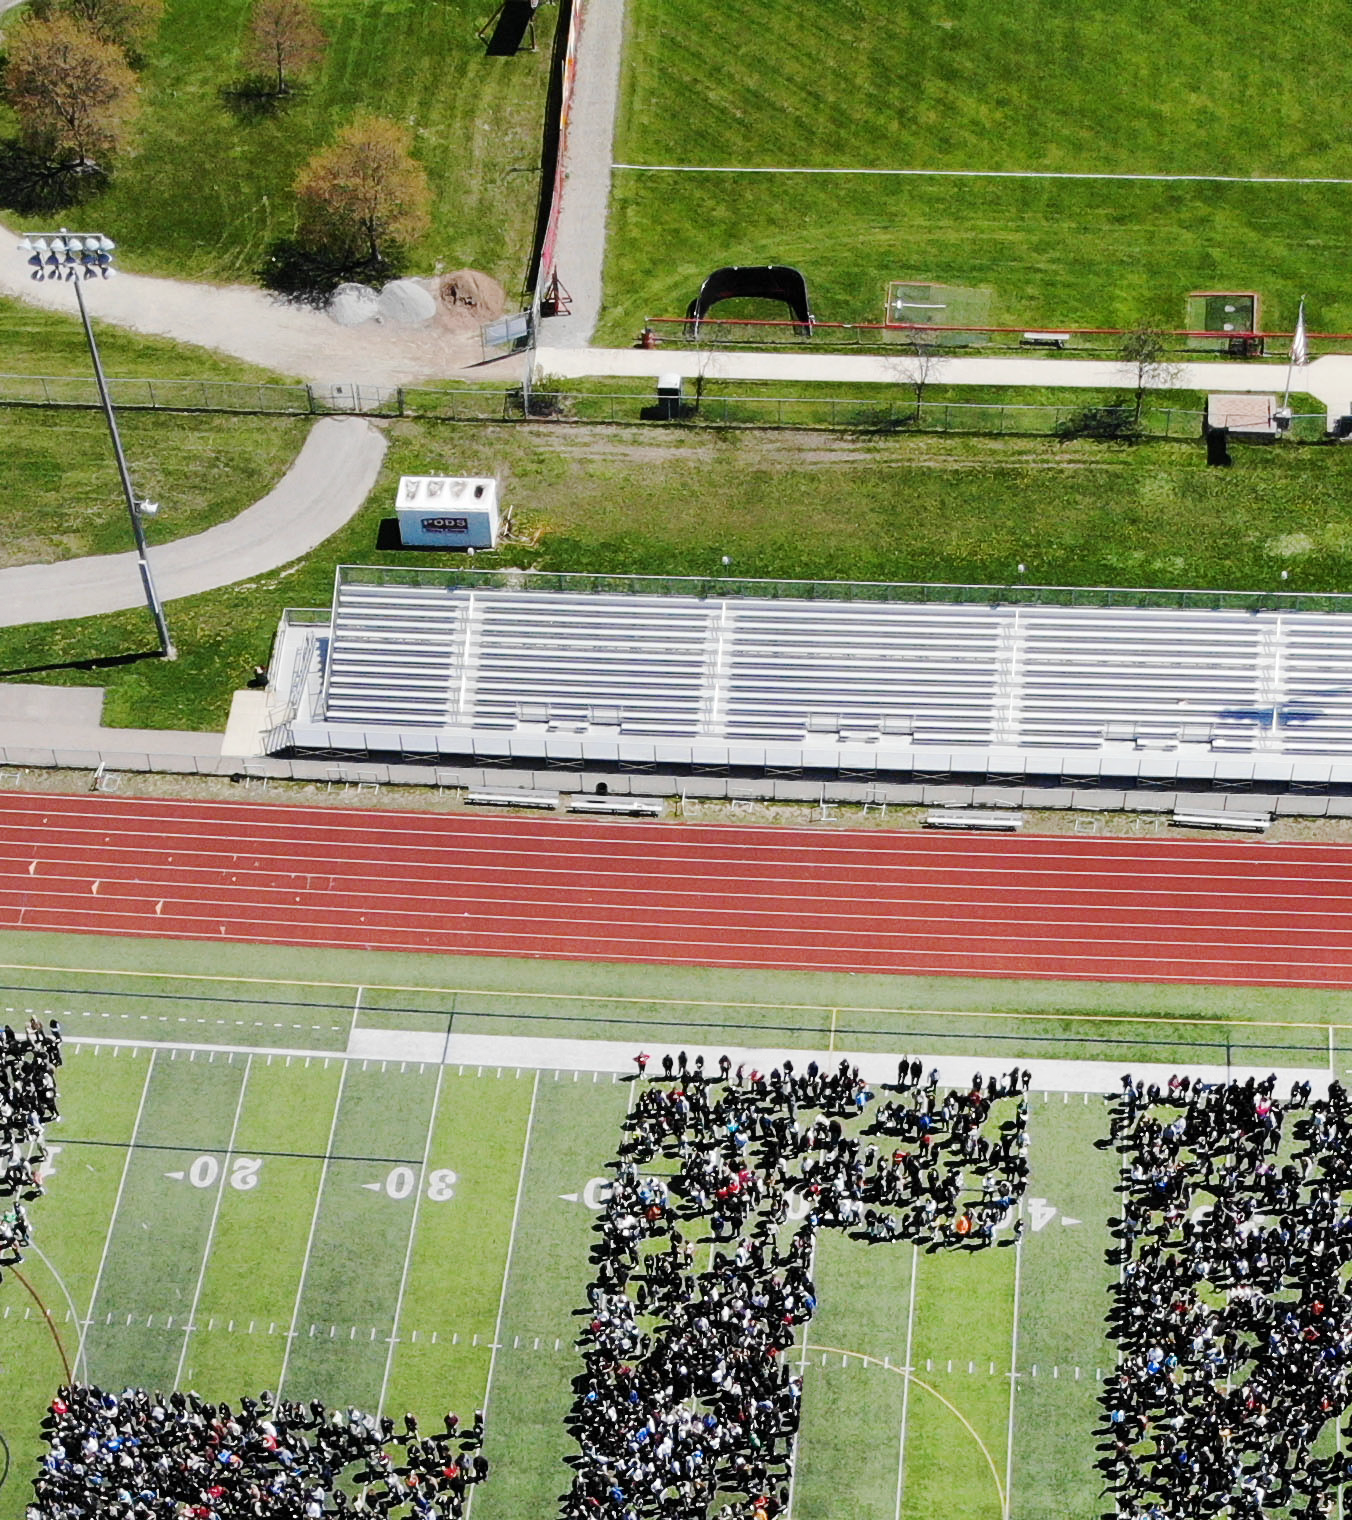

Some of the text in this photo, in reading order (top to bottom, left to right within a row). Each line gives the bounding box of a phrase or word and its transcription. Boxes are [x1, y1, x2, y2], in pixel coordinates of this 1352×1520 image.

[423, 518, 467, 528] PODS
[188, 1155, 264, 1192] 20
[385, 1166, 459, 1203] 30
